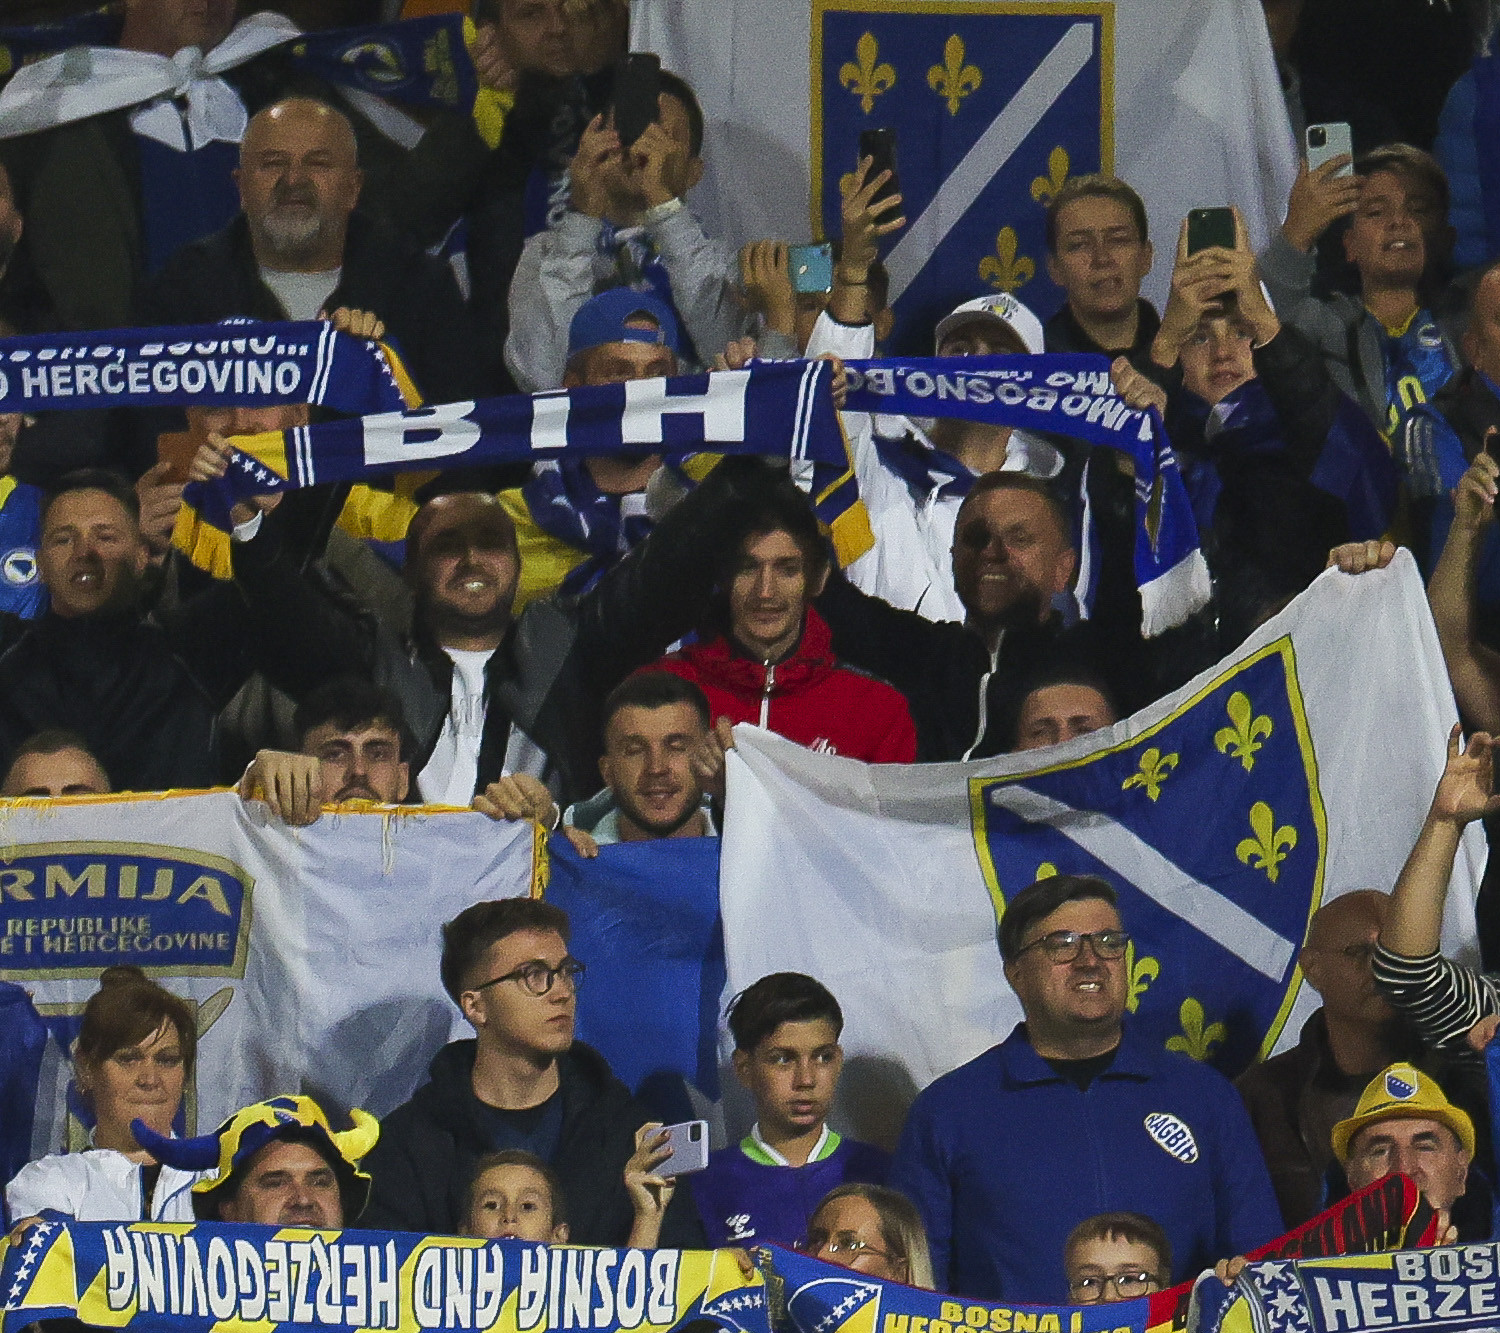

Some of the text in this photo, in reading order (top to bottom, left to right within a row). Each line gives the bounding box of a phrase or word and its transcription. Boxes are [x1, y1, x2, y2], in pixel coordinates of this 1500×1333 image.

[22, 349, 300, 397] HERCEGOVINO
[7, 916, 152, 938] REPUBLIKE
[25, 937, 31, 952] I
[41, 932, 231, 955] HERCEGOVINE
[103, 1226, 678, 1329] BOSNIA AND HERZEGOVINA
